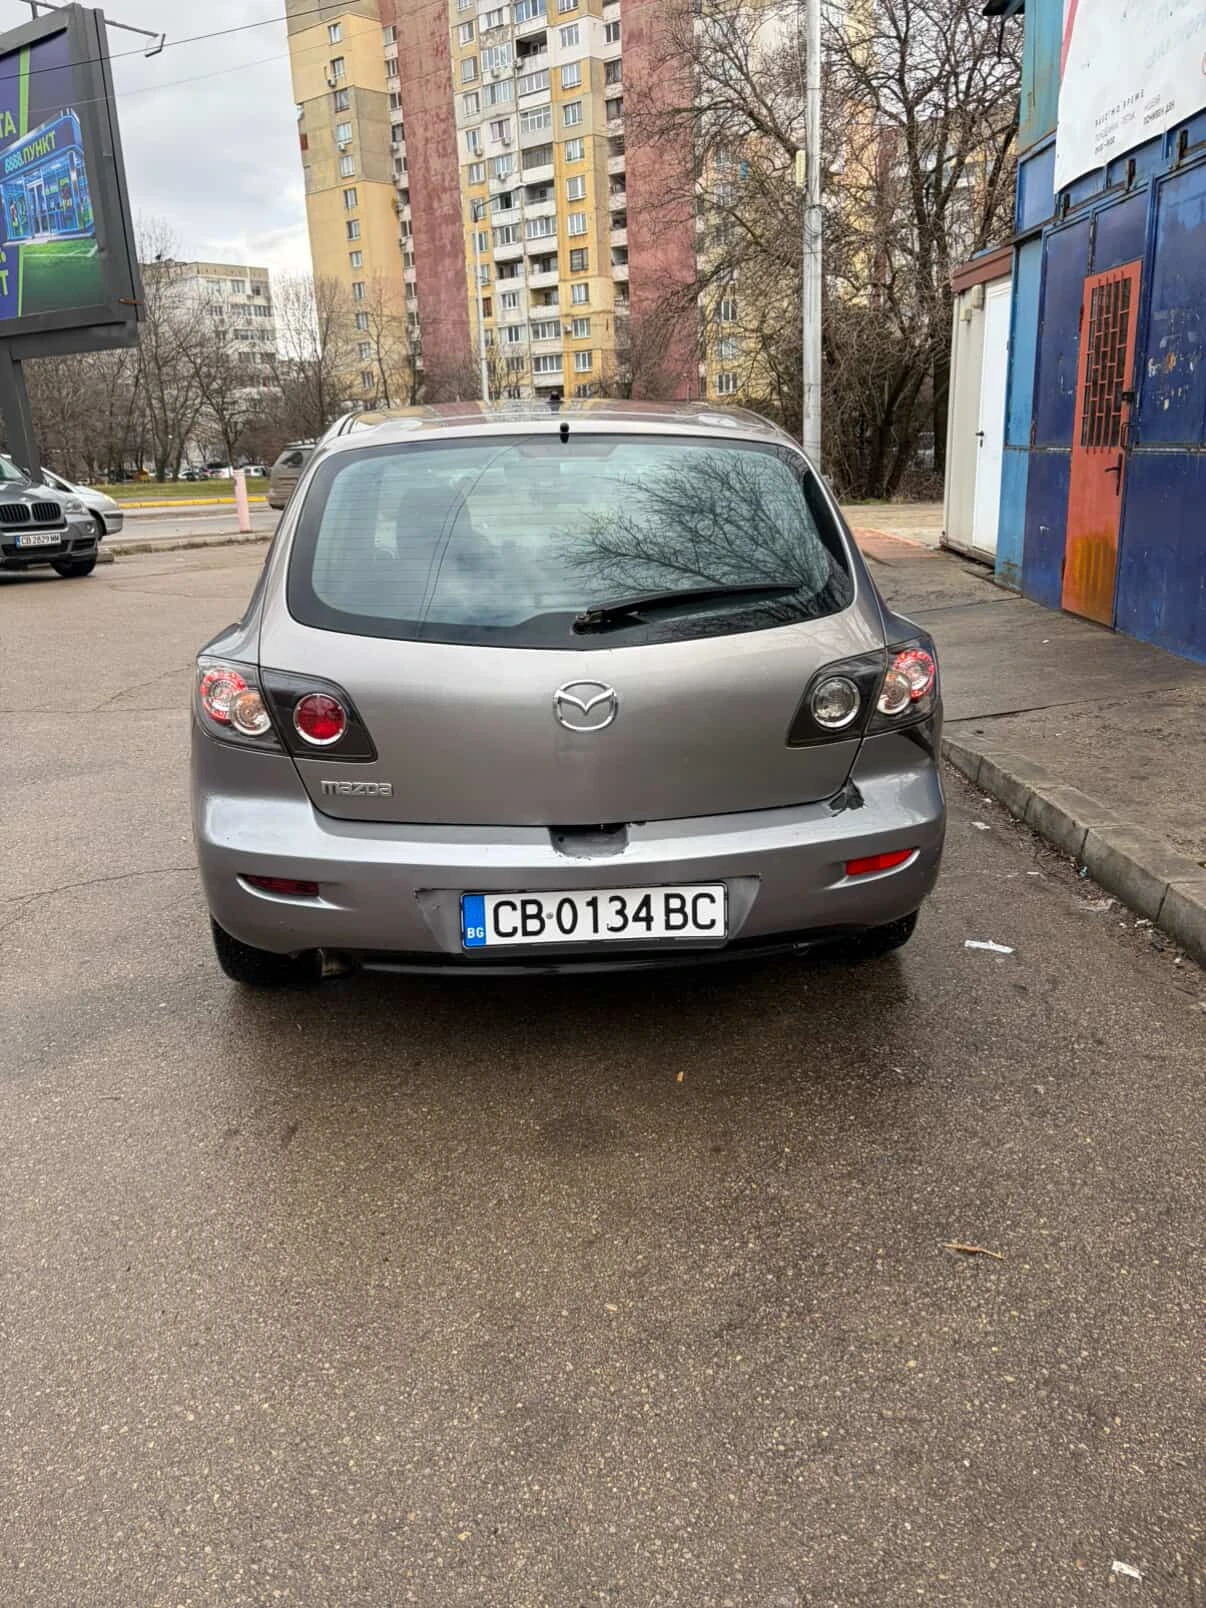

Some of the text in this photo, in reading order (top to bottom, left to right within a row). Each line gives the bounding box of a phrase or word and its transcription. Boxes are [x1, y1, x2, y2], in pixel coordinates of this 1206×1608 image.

[492, 892, 716, 938] CB 0134 BC
[467, 927, 484, 938] BG
